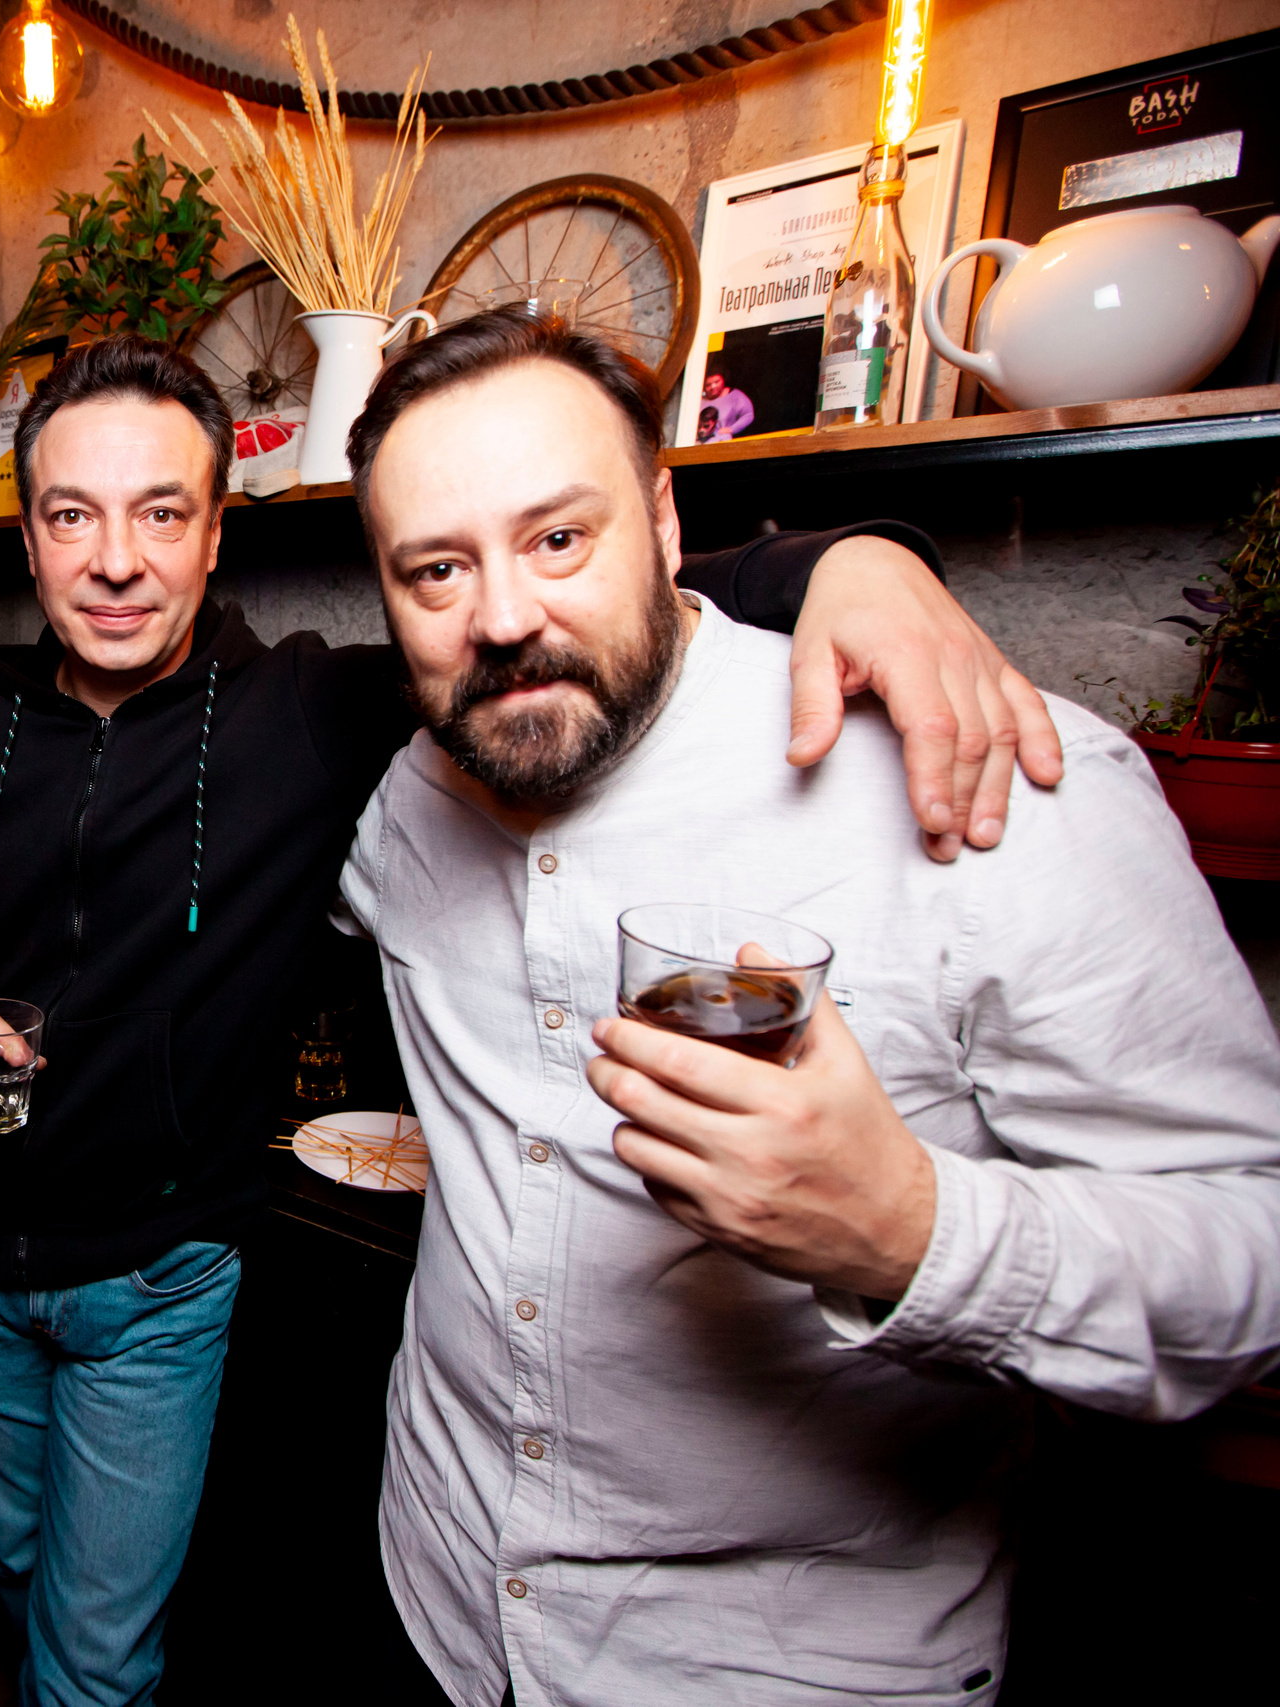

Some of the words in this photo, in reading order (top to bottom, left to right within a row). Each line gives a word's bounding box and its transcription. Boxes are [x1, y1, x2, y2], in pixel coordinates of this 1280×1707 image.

[1129, 81, 1200, 117] BASH
[1131, 106, 1192, 126] TODAY
[719, 275, 811, 314] Театральная
